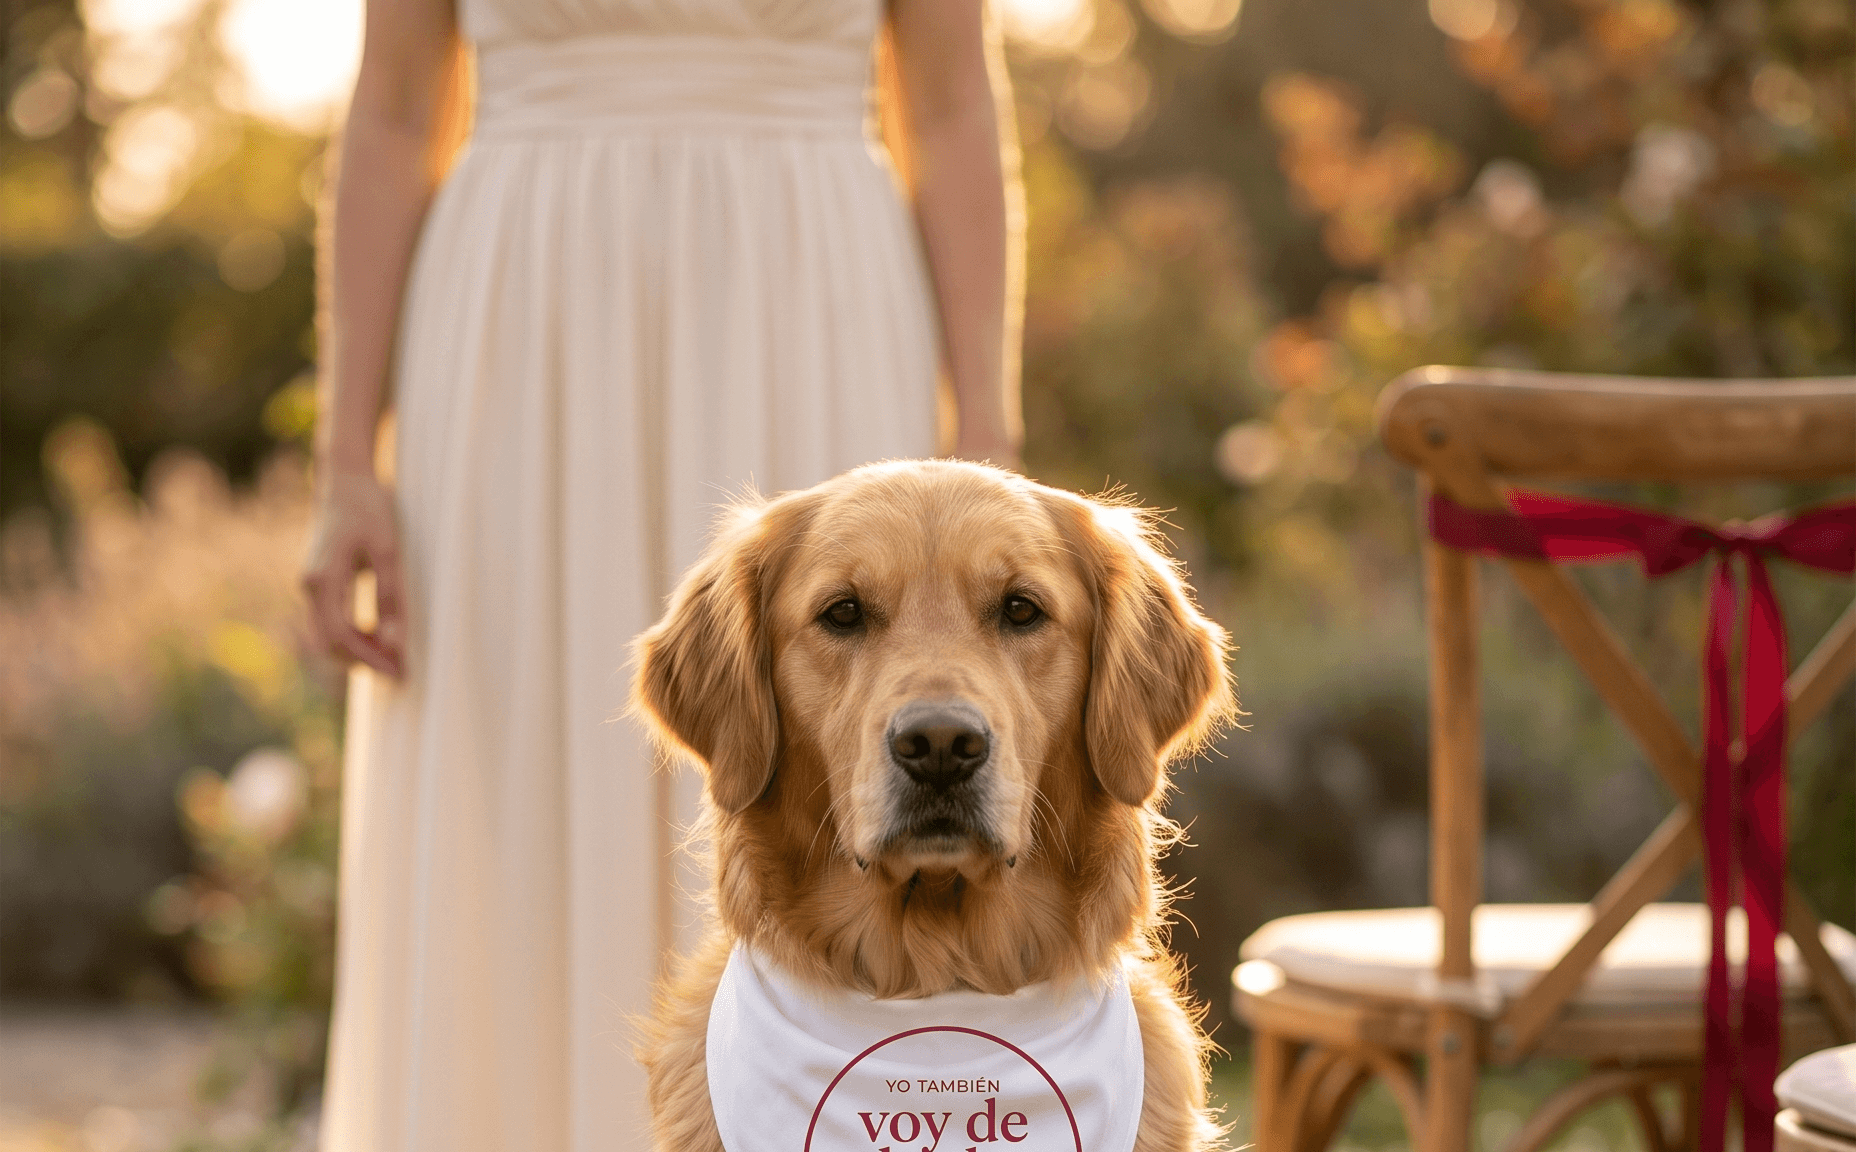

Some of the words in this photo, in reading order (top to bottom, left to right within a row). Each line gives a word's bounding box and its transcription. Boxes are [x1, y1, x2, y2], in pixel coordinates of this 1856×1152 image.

[886, 1079, 910, 1093] YO
[917, 1077, 1000, 1093] TAMBIÉN
[966, 1097, 1029, 1143] de
